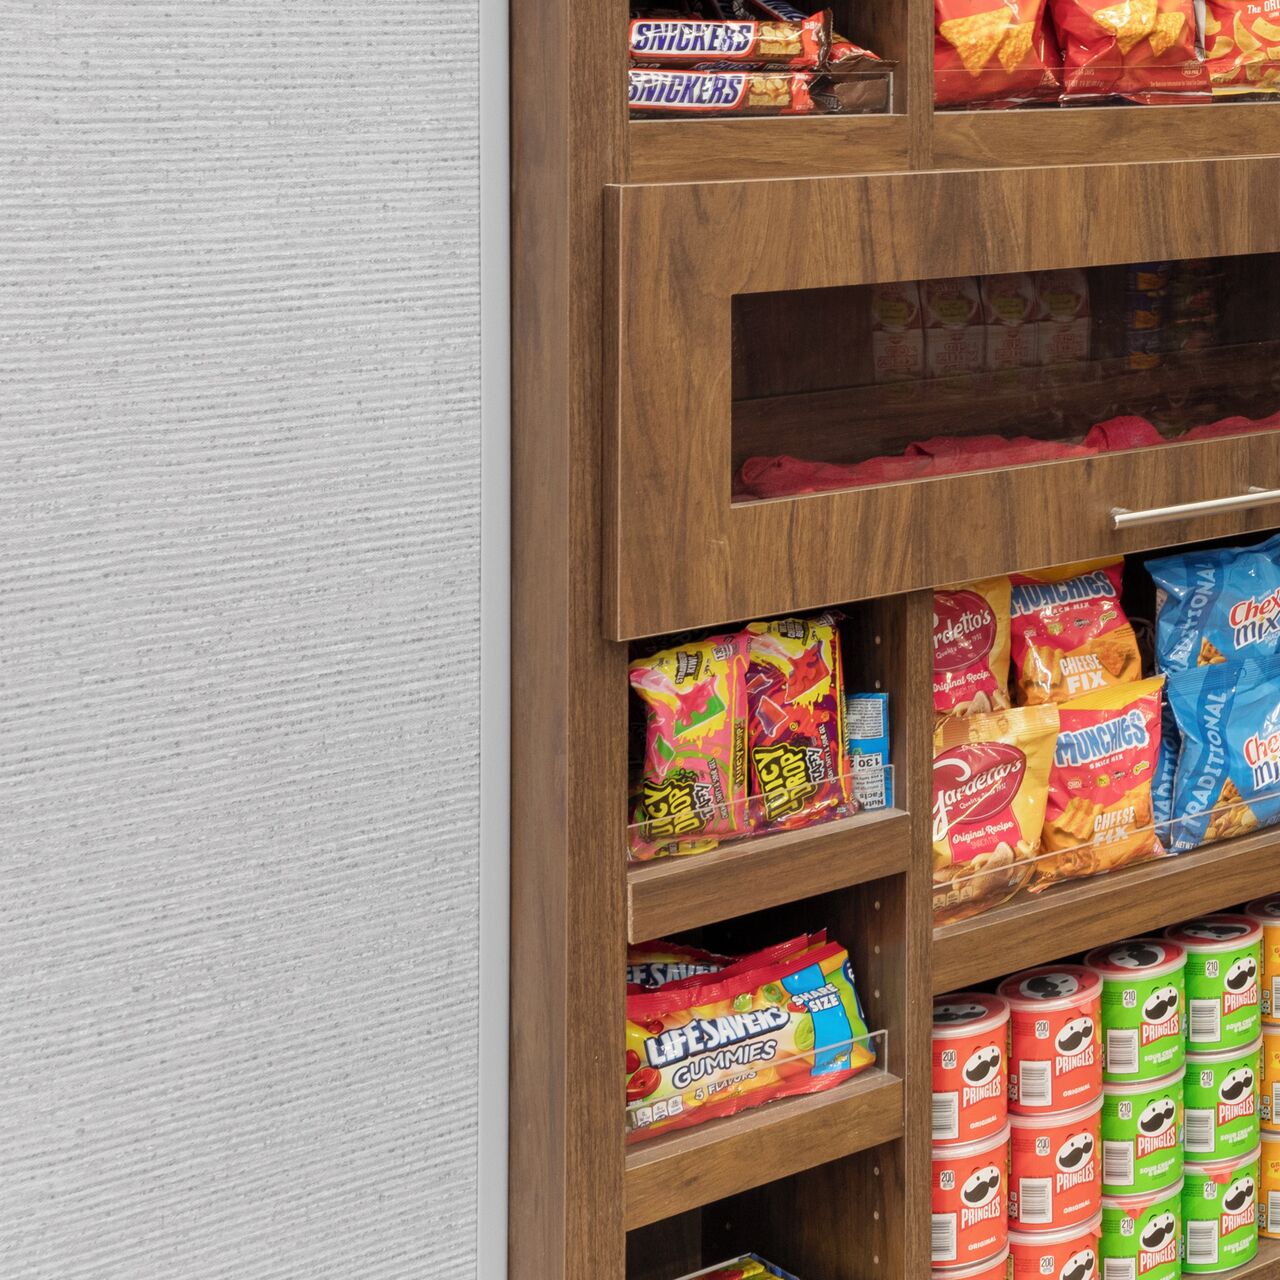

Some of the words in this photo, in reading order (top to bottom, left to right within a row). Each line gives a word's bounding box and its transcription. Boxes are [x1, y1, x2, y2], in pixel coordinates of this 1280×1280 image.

[1247, 4, 1263, 15] The
[631, 22, 753, 53] SNICKERS
[629, 71, 744, 105] SNICKERS
[1010, 570, 1115, 615] MUNCHIES
[1059, 652, 1102, 677] CHEESE
[1066, 673, 1108, 696] FIX
[1055, 710, 1148, 767] MUNCHIES
[1110, 753, 1124, 764] MIX
[1183, 689, 1228, 832] TRADITIONAL
[951, 825, 986, 844] Original
[986, 819, 1014, 837] Recipe
[1093, 806, 1136, 830] CHEESE
[791, 982, 840, 1006] SHARE
[808, 993, 841, 1013] SIZE
[1223, 986, 1258, 1013] PRINGLES
[672, 1040, 779, 1090] GUMMIES
[694, 1087, 705, 1101] 5
[707, 1070, 757, 1097] FLAVORS
[962, 1077, 1001, 1108] PRINGLES
[969, 1116, 998, 1130] ORIGINAL
[1218, 1096, 1255, 1125] PRINGLES
[1137, 1128, 1176, 1157] PRINGLES
[940, 1171, 955, 1184] 200
[1056, 1163, 1094, 1193] PRINGLES
[1204, 1182, 1218, 1193] 210
[961, 1199, 1000, 1229] PRINGLES
[1222, 1208, 1256, 1236] PRINGLES
